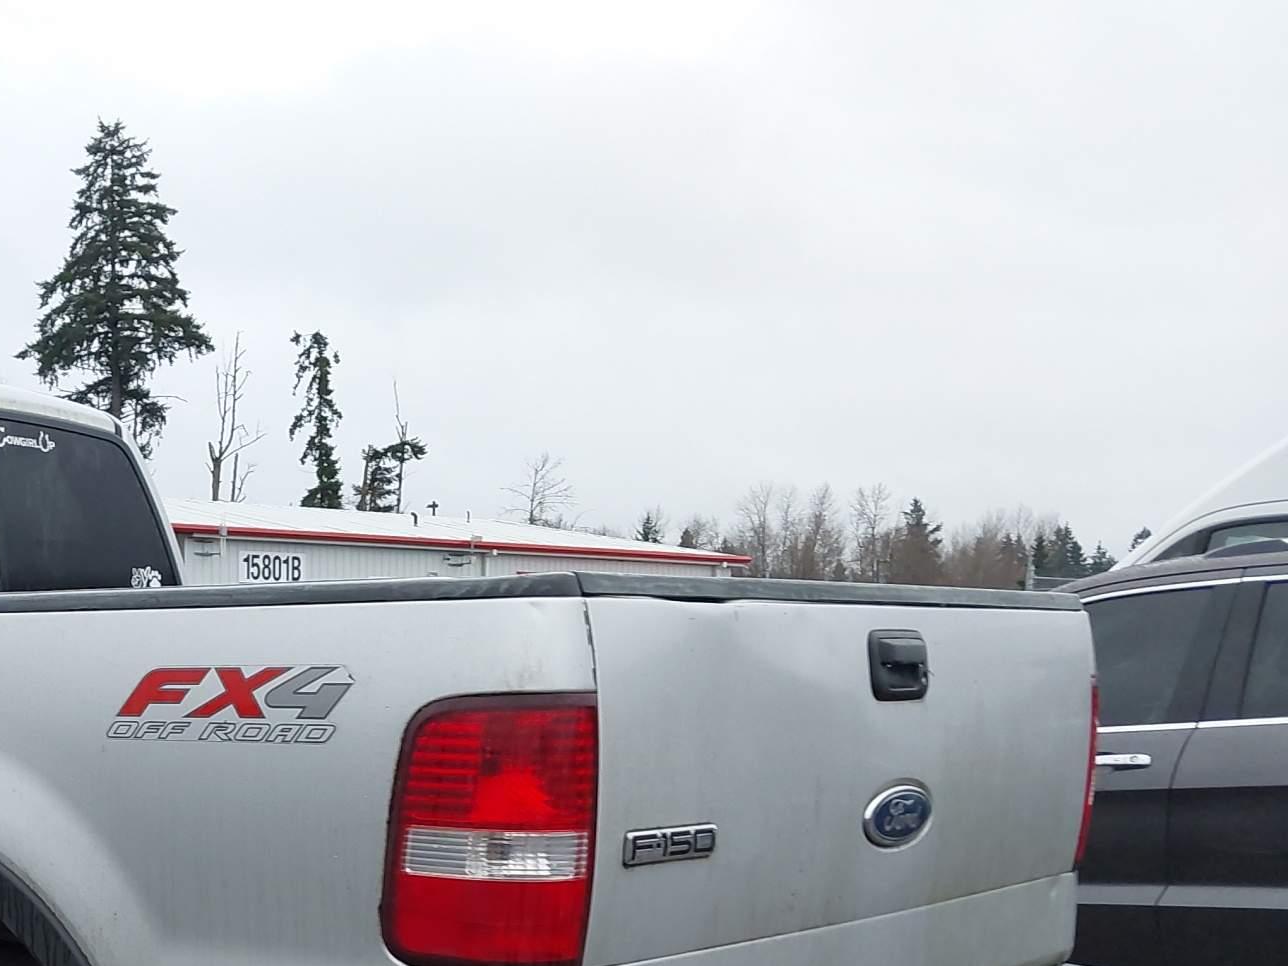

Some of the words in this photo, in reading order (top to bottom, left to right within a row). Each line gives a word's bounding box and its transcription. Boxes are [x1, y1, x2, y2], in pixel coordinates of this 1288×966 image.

[243, 554, 301, 581] 15801B
[116, 666, 355, 720] FX4
[106, 720, 192, 740] OFF
[197, 721, 337, 744] ROAD
[884, 797, 922, 832] Ford
